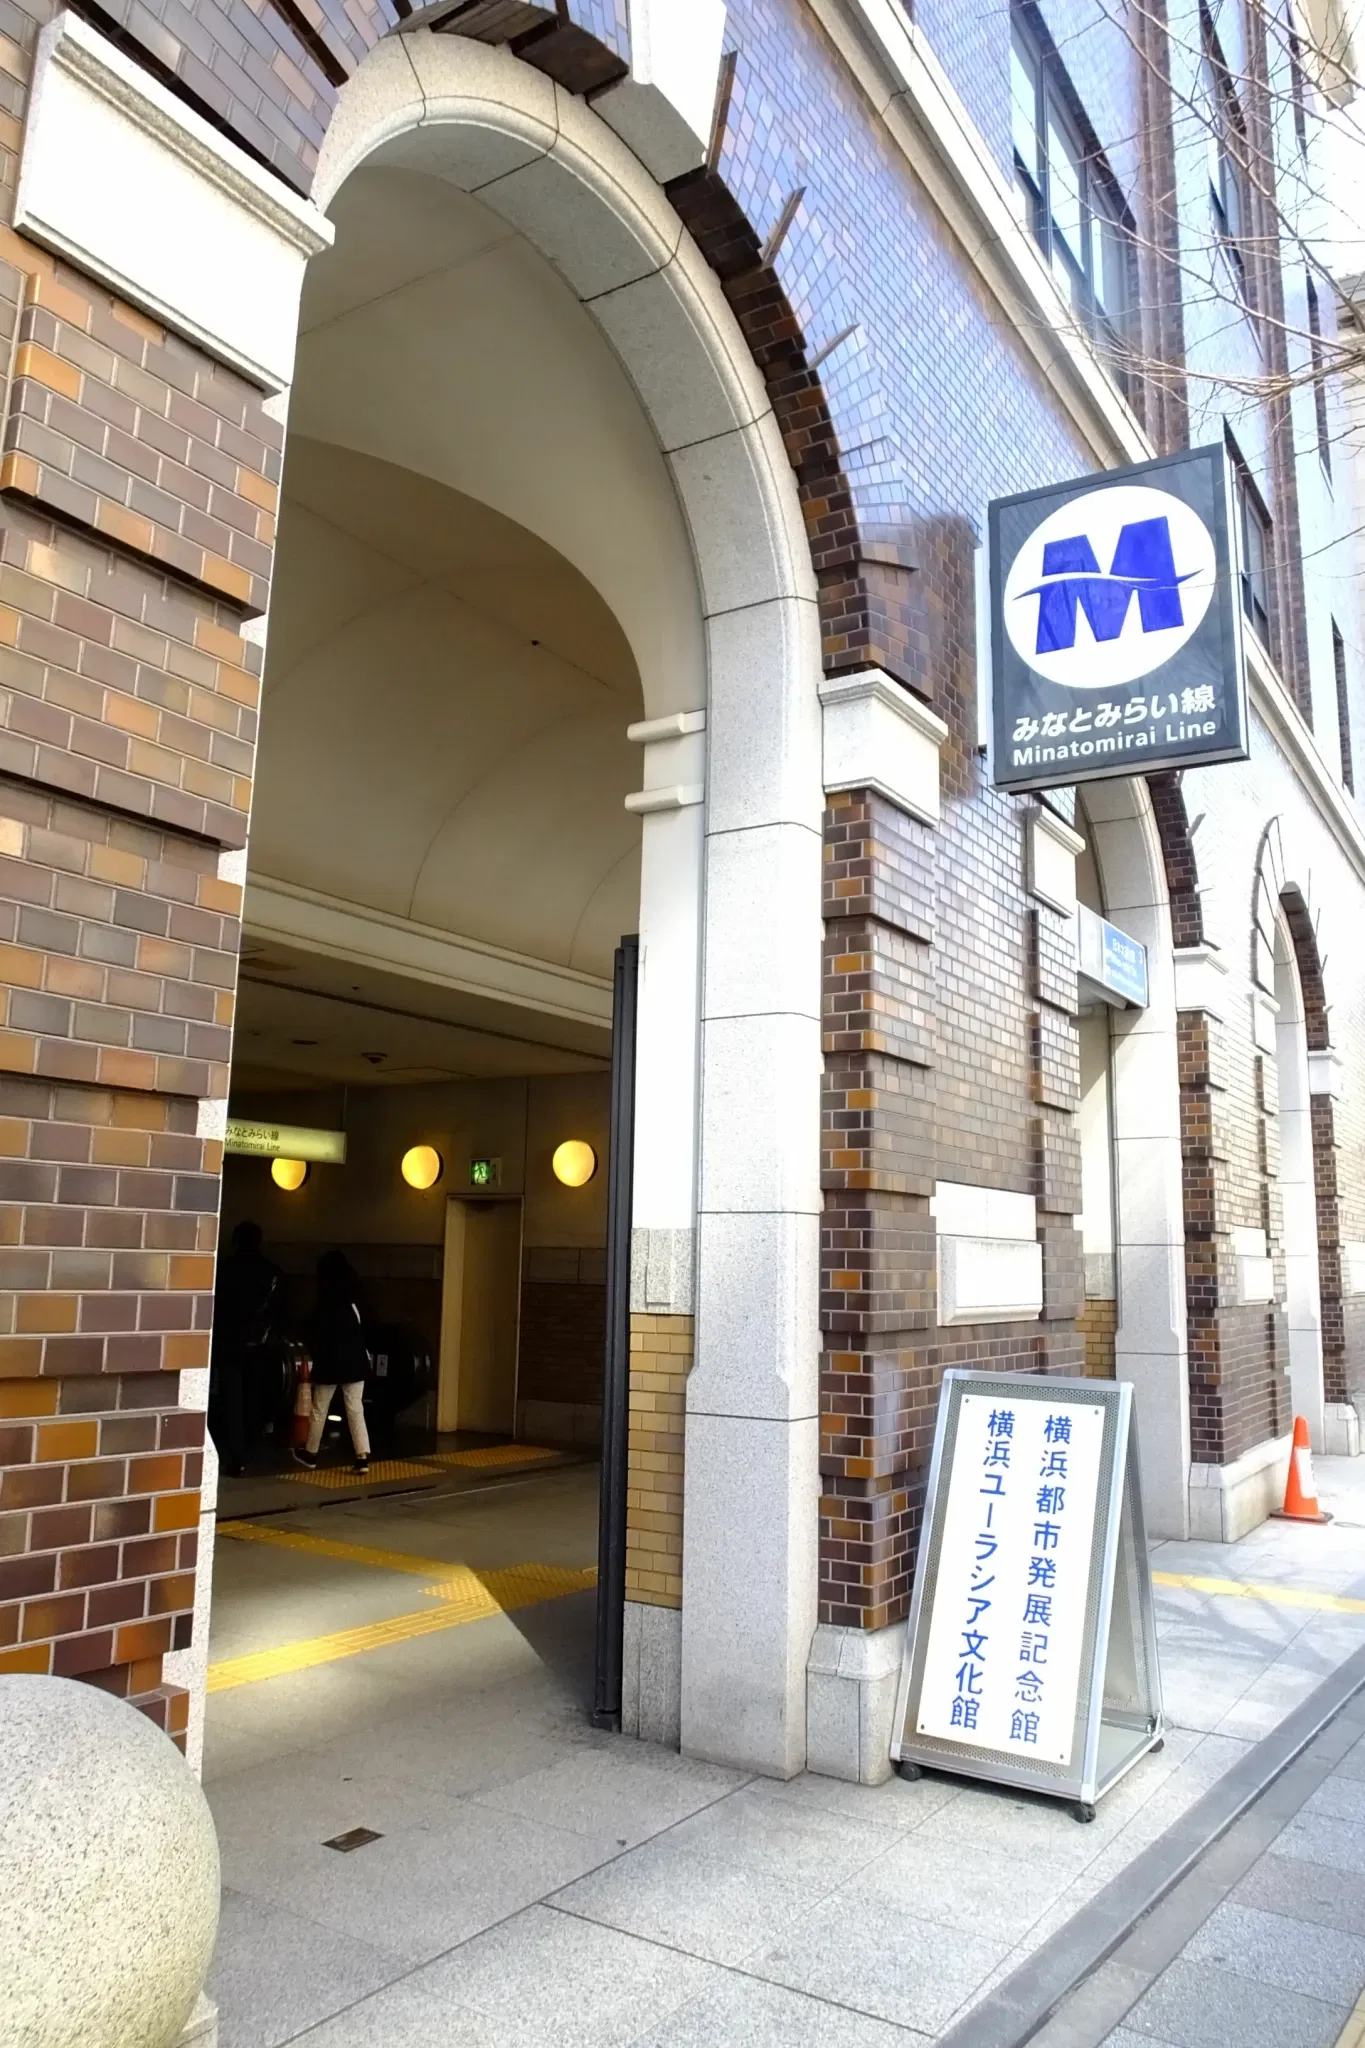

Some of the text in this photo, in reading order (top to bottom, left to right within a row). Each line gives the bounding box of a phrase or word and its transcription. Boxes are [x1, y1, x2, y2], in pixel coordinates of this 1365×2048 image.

[1012, 684, 1216, 742] みなとみらい線
[1012, 720, 1216, 767] Minatomirai Line
[949, 1408, 1015, 1731] 横浜ユーラシア文化館
[1008, 1414, 1073, 1744] 横浜都市発展記念館
